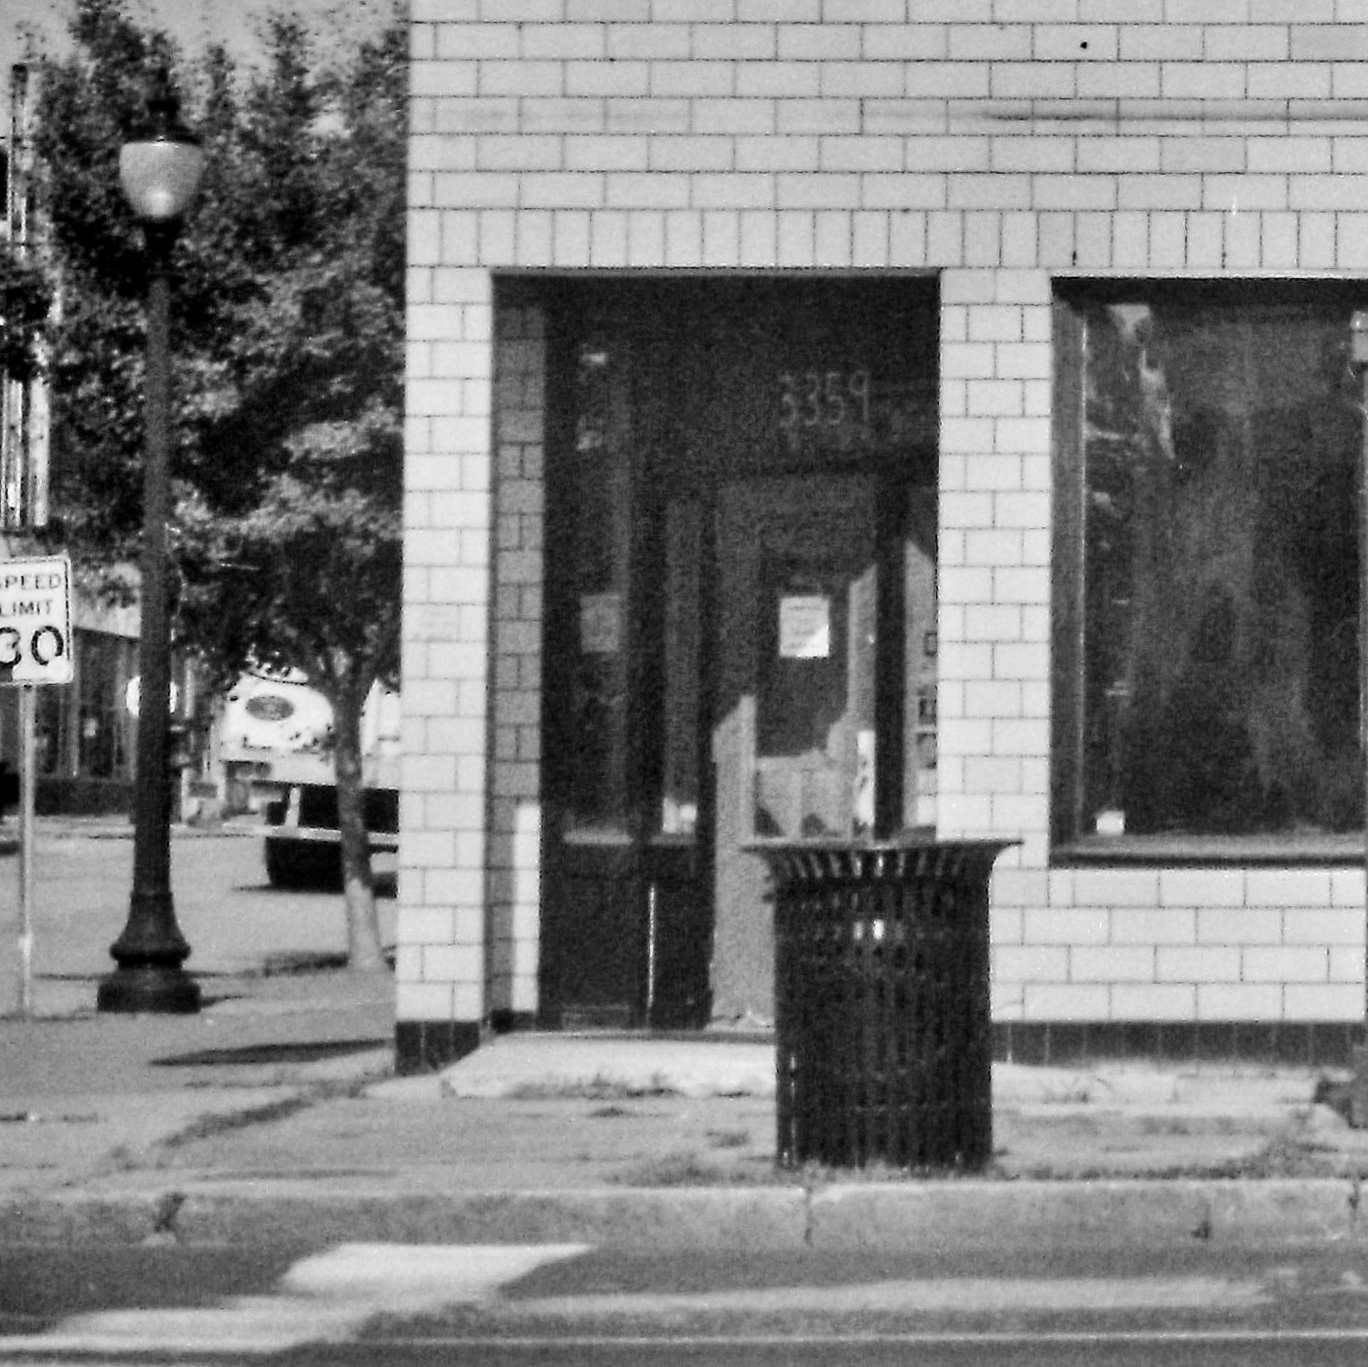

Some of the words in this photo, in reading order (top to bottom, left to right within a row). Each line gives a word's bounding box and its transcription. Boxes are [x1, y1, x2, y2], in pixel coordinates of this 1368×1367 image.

[779, 369, 870, 427] 3359
[0, 574, 62, 590] PEED
[0, 625, 64, 666] 30
